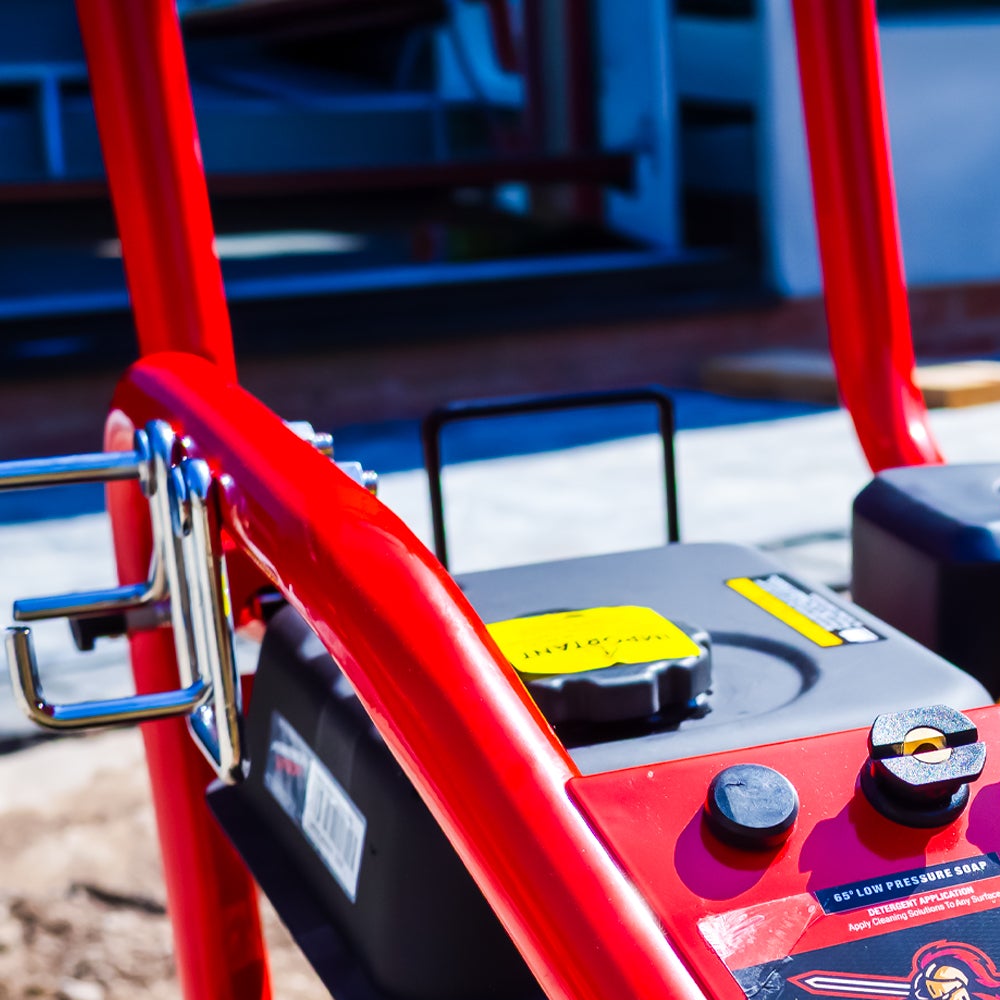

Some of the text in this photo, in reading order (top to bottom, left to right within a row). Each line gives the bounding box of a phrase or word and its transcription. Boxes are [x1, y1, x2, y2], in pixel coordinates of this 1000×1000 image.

[856, 884, 884, 897] LOW
[885, 868, 953, 891] PRESSURE
[954, 861, 987, 876] SOAP
[848, 918, 872, 932] Apply
[872, 911, 908, 926] Cleaning
[908, 902, 945, 918] Solutions
[945, 900, 955, 909] To
[955, 897, 971, 908] Any
[867, 886, 974, 917] DETERGENT APPLICATION
